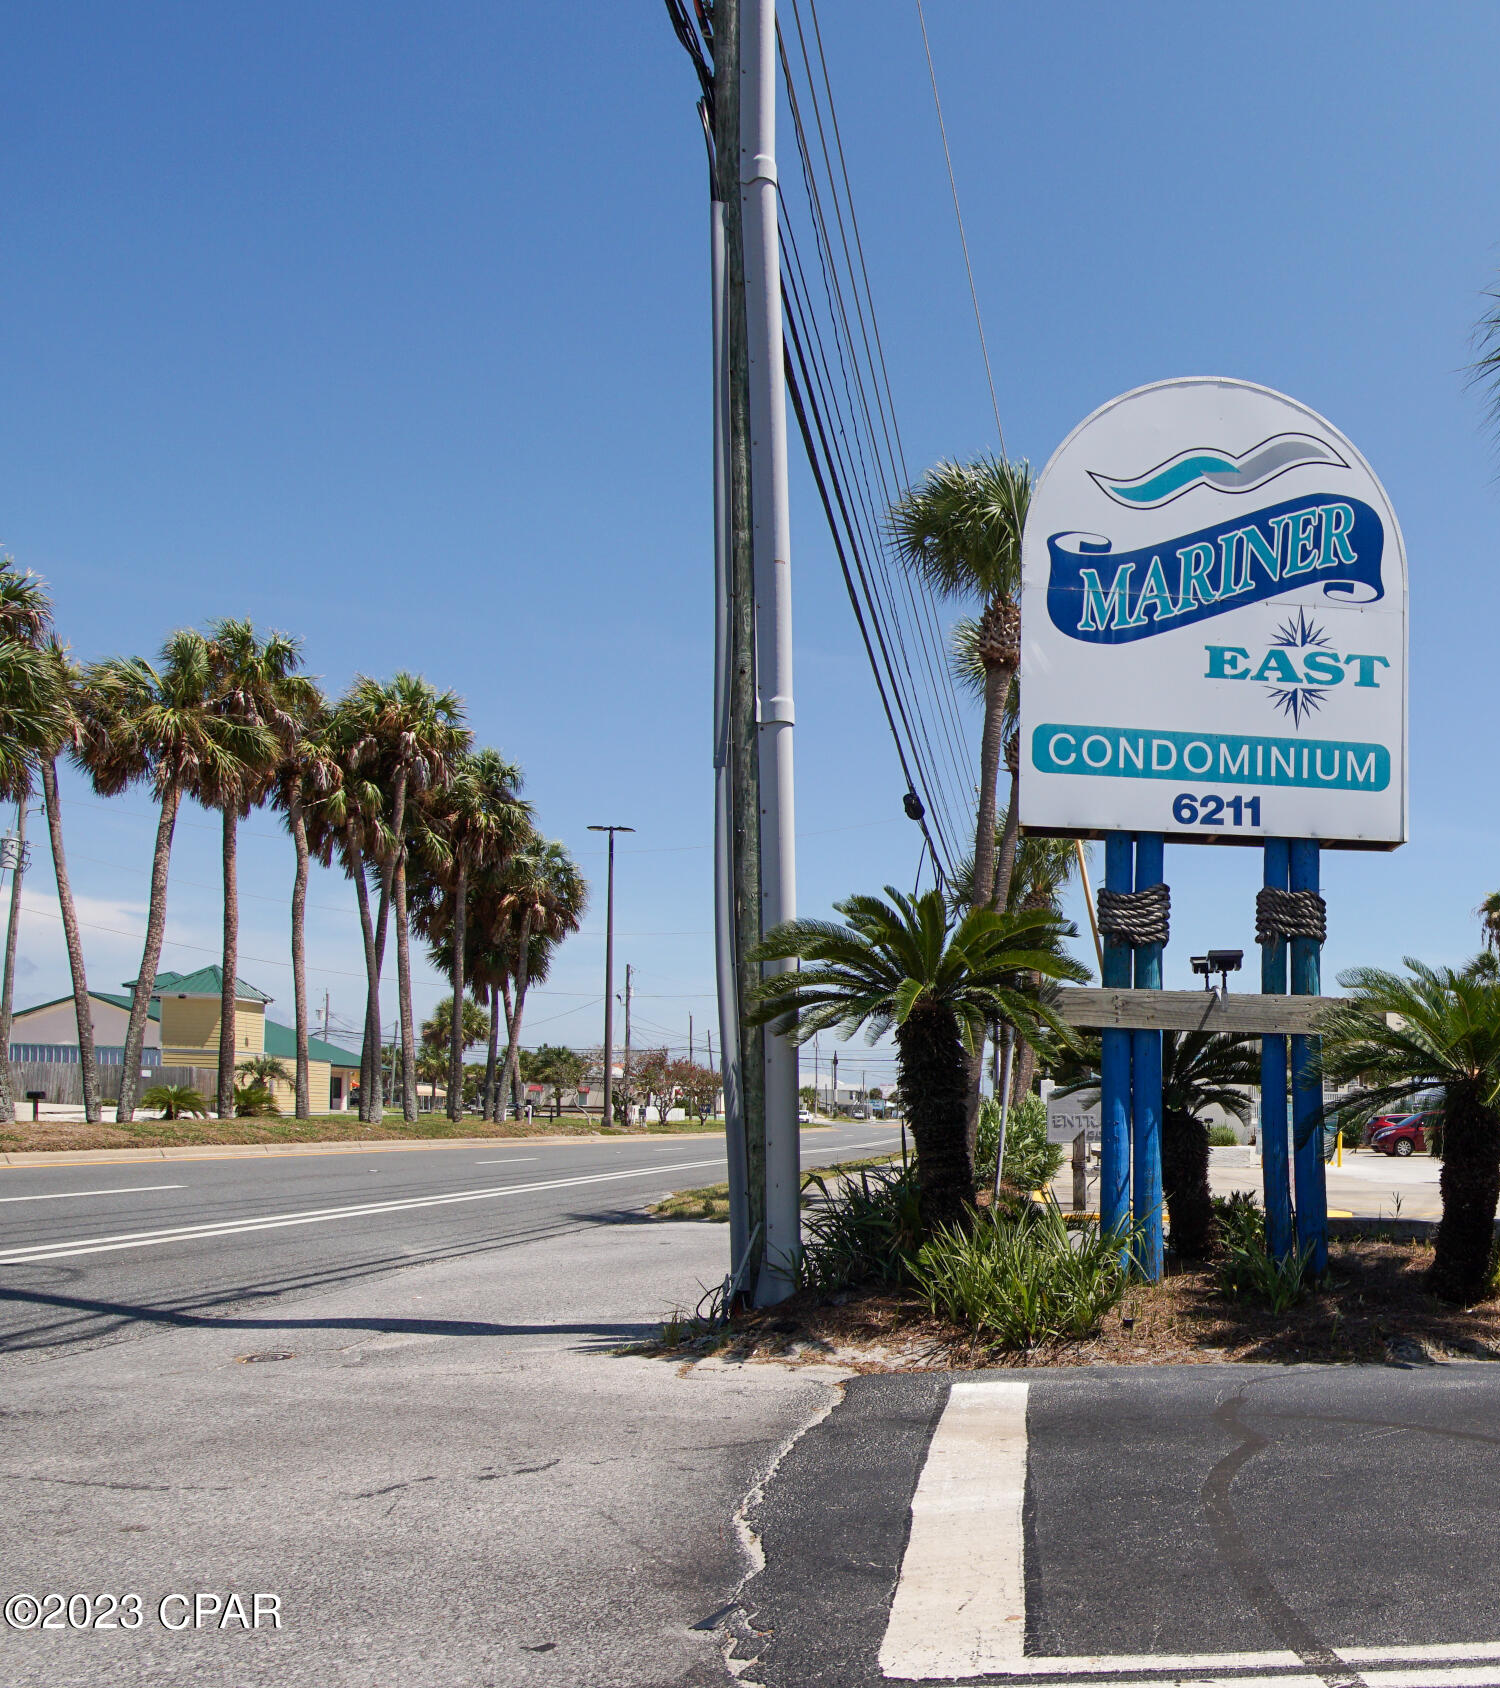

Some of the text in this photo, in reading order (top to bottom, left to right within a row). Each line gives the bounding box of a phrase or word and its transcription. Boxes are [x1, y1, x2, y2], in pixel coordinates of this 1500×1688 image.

[1077, 503, 1358, 632] MARINER
[1204, 645, 1391, 688] EAST
[1048, 732, 1377, 784] CONDOMINIUM
[1172, 793, 1262, 828] 6211
[1052, 1114, 1101, 1129] ENTR
